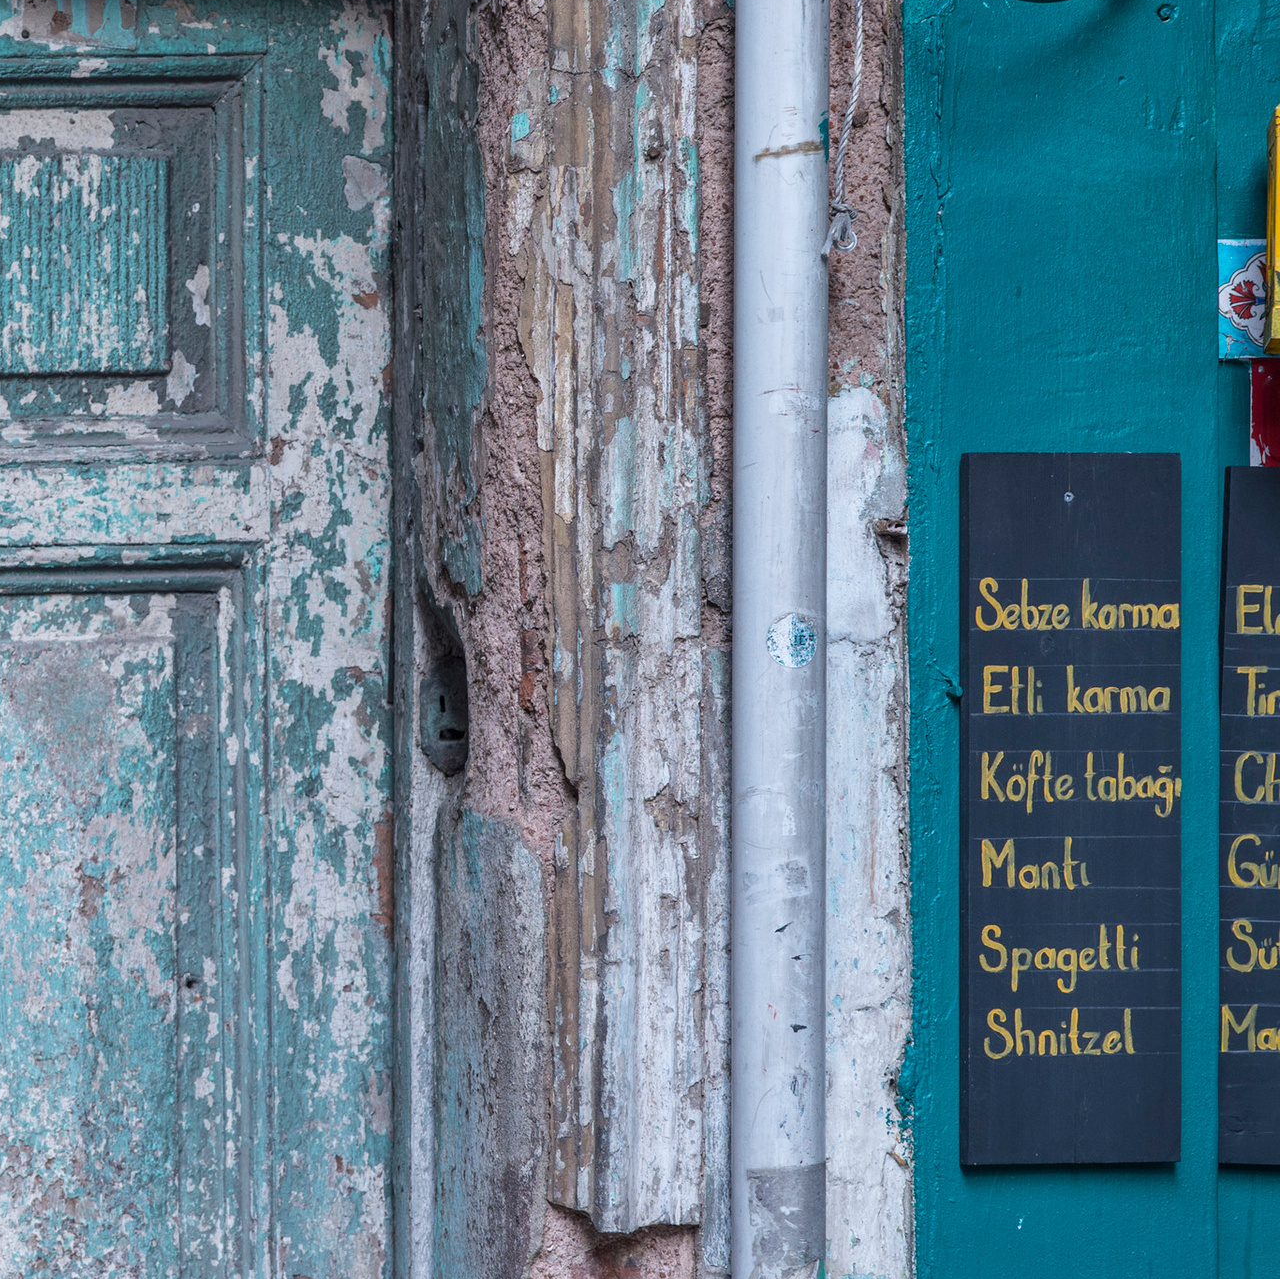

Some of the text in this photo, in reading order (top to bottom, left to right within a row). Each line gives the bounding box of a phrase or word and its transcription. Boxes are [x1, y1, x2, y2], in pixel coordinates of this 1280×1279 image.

[975, 577, 1180, 631] Sebze karma
[983, 664, 1171, 715] Etli karma
[981, 750, 1181, 818] Köfte tabağı
[981, 836, 1092, 890] Mantı
[1228, 833, 1280, 888] Gü
[979, 924, 1140, 993] Spagetti
[1226, 919, 1280, 973] Sü
[984, 1008, 1136, 1060] Shnitzel
[1221, 1004, 1280, 1054] Ma
